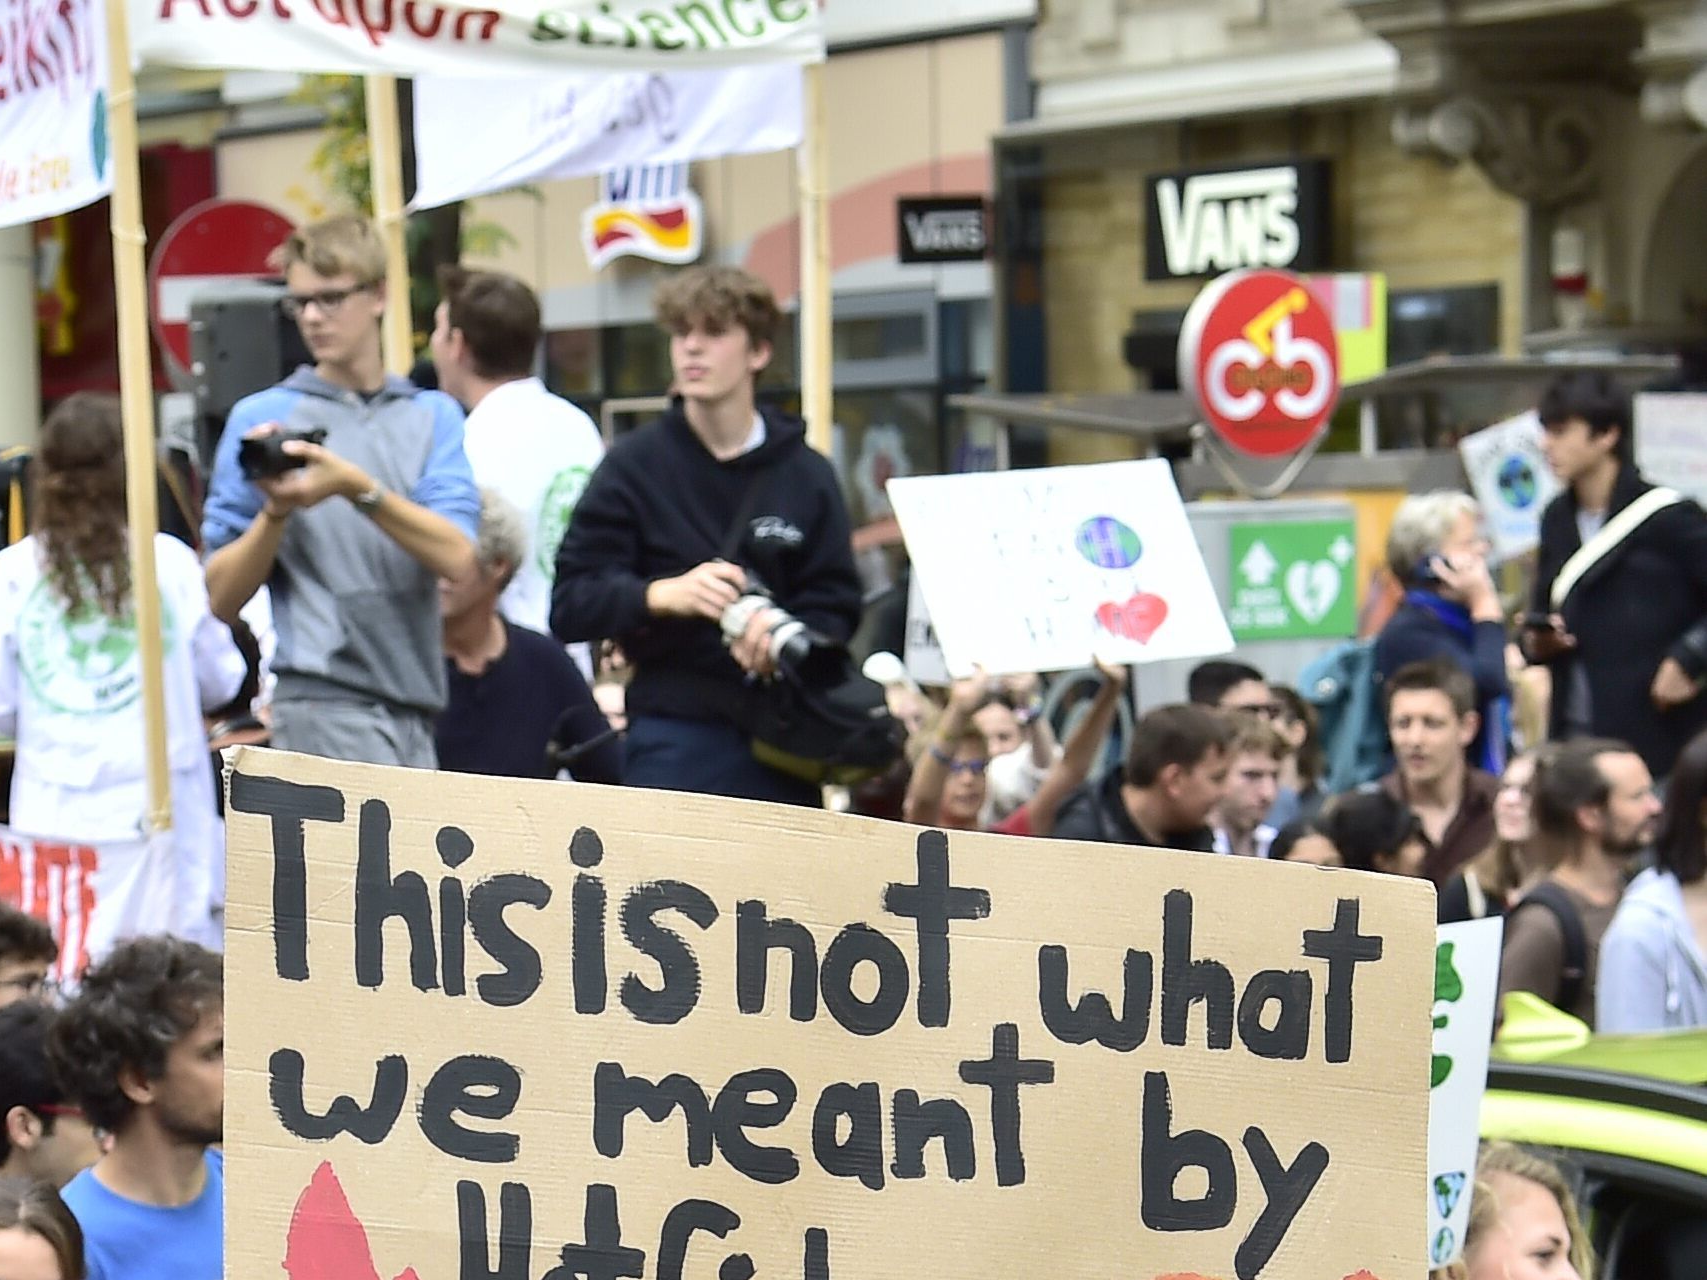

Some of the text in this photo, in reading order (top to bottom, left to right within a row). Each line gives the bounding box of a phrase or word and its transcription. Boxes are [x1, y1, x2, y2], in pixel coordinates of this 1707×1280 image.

[1156, 166, 1300, 276] VANS
[230, 771, 1383, 1063] This is not what
[269, 1048, 523, 1164] we
[594, 1023, 1055, 1191] meant
